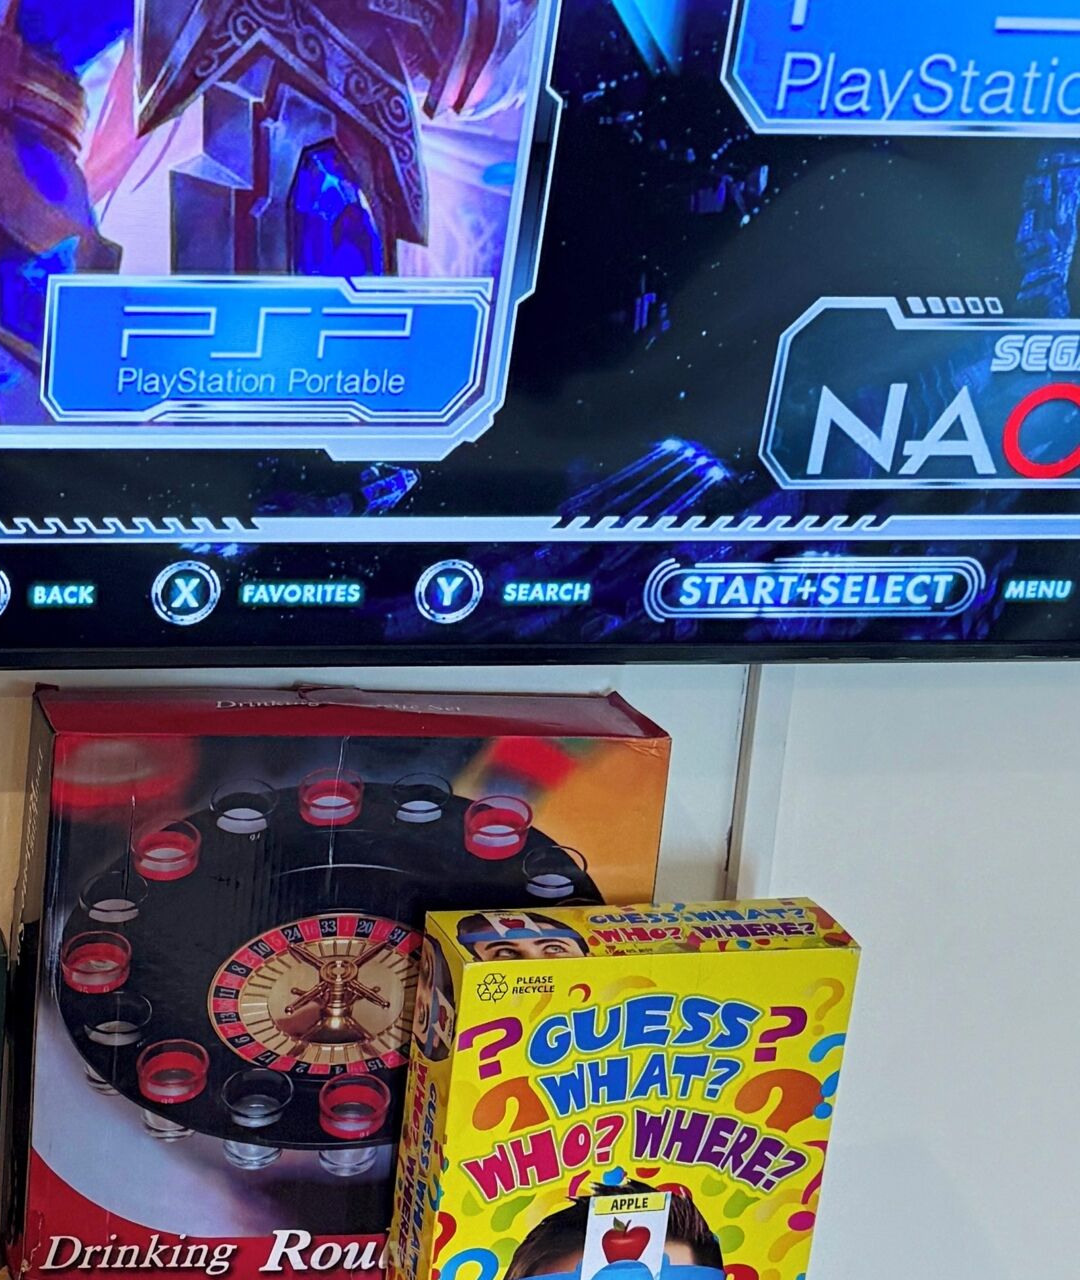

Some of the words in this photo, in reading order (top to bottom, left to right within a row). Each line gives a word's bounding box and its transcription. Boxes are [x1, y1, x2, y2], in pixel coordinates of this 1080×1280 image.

[120, 305, 415, 360] PSP
[990, 334, 1080, 372] SEG
[118, 368, 276, 399] PlayStation
[287, 368, 406, 394] Portable
[33, 585, 95, 605] BACK
[170, 578, 200, 608] X
[242, 583, 362, 604] FAVORITES
[436, 578, 463, 606] Y
[503, 582, 591, 603] SEARCH
[678, 574, 954, 606] START+SELECT
[1004, 580, 1073, 600] MENU
[589, 911, 683, 924] GUESS
[686, 907, 807, 922] WHAT?
[284, 927, 302, 942] 24
[321, 920, 337, 933] 33
[357, 920, 373, 934] 20
[389, 927, 406, 942] 31
[592, 926, 682, 943] WHO?
[694, 922, 816, 939] WHERE?
[252, 942, 270, 955] 10
[512, 983, 556, 996] RECYCLE
[515, 974, 555, 986] PLEASE
[528, 993, 764, 1066] GUESS
[539, 1053, 744, 1117] WHAT?
[461, 1113, 626, 1200] WHO?
[633, 1107, 809, 1194] WHERE?
[610, 1196, 649, 1212] APPLE
[39, 1233, 237, 1276] Drinking
[259, 1228, 388, 1273] Rou
